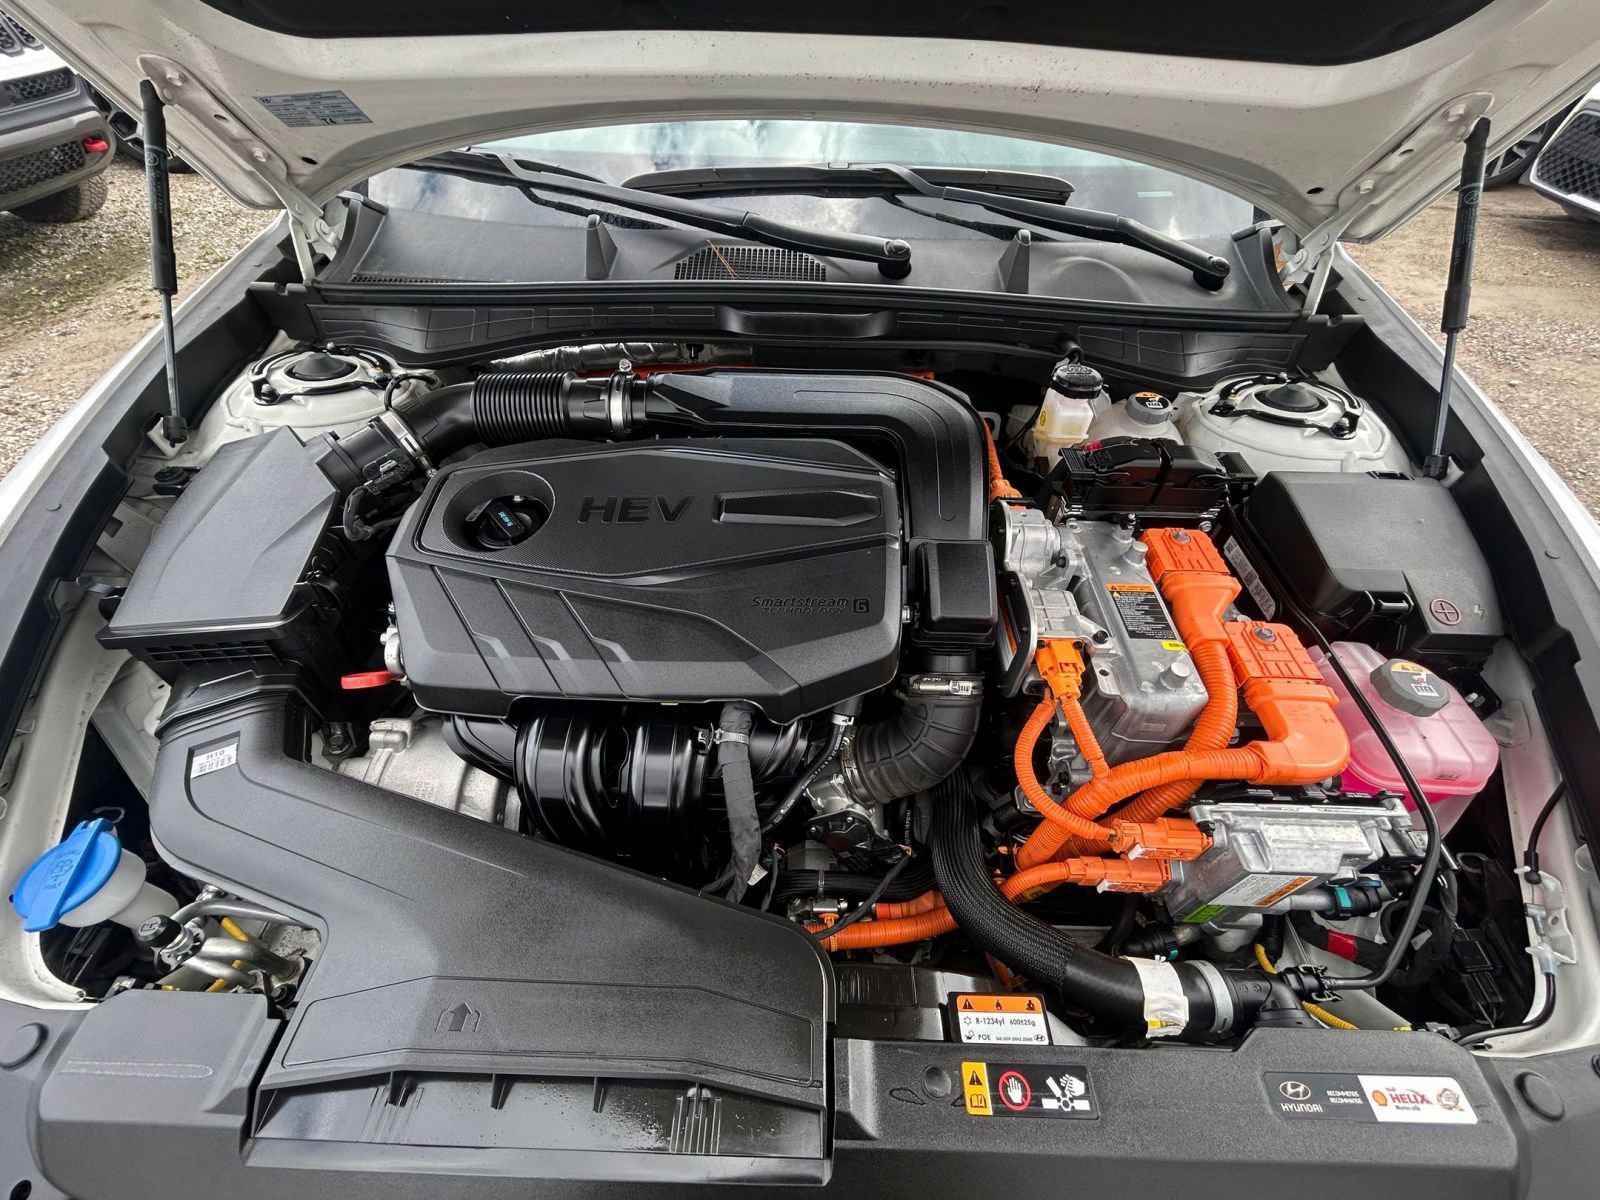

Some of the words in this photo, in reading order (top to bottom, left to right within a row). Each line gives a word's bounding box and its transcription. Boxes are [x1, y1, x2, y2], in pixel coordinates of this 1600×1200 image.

[577, 495, 694, 524] HEV
[751, 596, 848, 608] Smartstream
[978, 1033, 991, 1041] POE
[1389, 1093, 1432, 1105] HELIX
[1280, 1102, 1324, 1113] HYUNDAI
